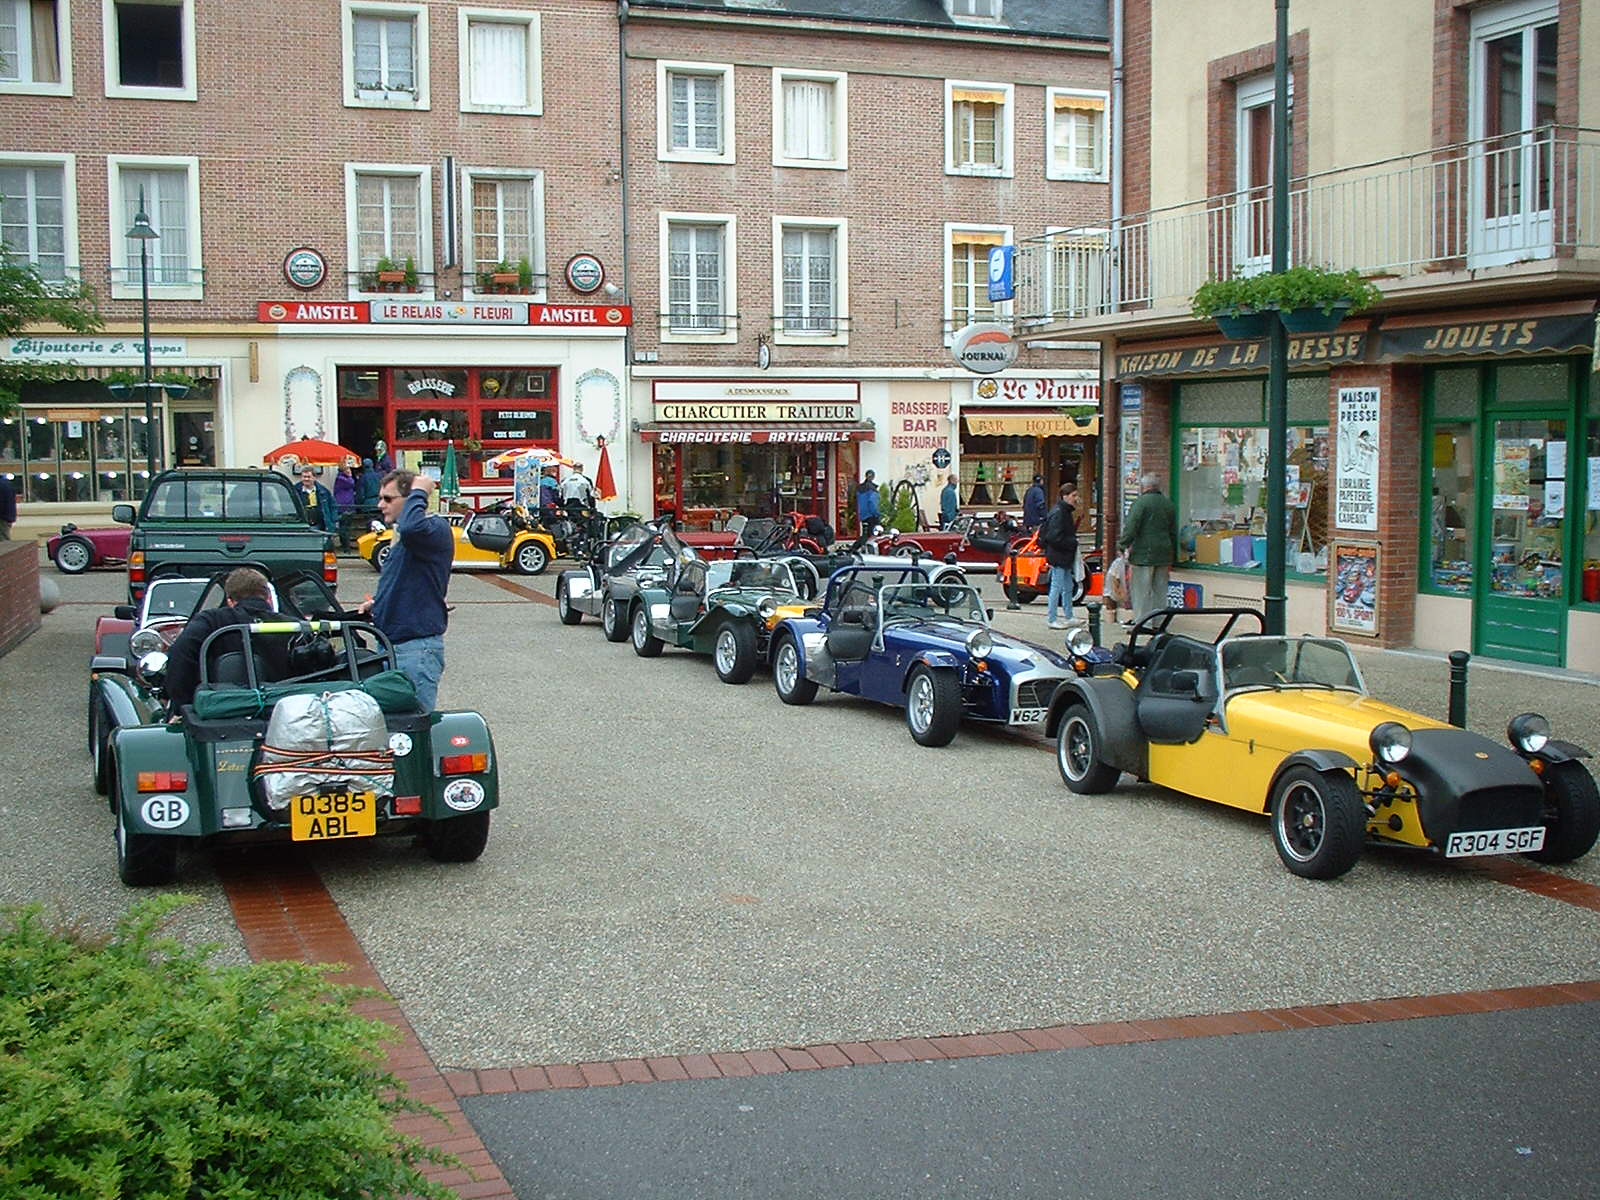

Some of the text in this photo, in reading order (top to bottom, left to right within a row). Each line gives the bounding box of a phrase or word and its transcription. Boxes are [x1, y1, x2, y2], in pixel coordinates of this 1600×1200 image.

[296, 304, 358, 320] AMSTEL
[384, 305, 512, 319] LE RELAIS FLEURI
[540, 308, 597, 323] AMSTEL
[1423, 321, 1537, 349] JOUETS
[12, 338, 104, 356] Bijouterie
[1120, 335, 1360, 374] MAISON DE LA RESSE
[407, 378, 456, 396] BRASSERIE
[1003, 378, 1028, 400] Le
[1341, 391, 1377, 402] MAISON
[663, 405, 855, 419] CHARCUTIER TRAITEUR
[892, 402, 948, 415] BRASSERIE
[1341, 410, 1377, 421] PRESSE
[416, 418, 449, 433] BAR
[903, 419, 937, 431] BAR
[978, 420, 1072, 432] BAR HOTEL
[660, 431, 851, 443] CHARCUTERIE ARTISANALE
[892, 436, 948, 448] RESTAURANT
[1339, 478, 1372, 489] LIBRAIRIE
[1339, 490, 1373, 501] PAPETERIE
[1339, 512, 1367, 524] CADEAUX
[300, 792, 366, 815] Q385
[149, 800, 182, 822] GB
[309, 816, 358, 838] ABL
[1449, 830, 1543, 853] R304 SGF
